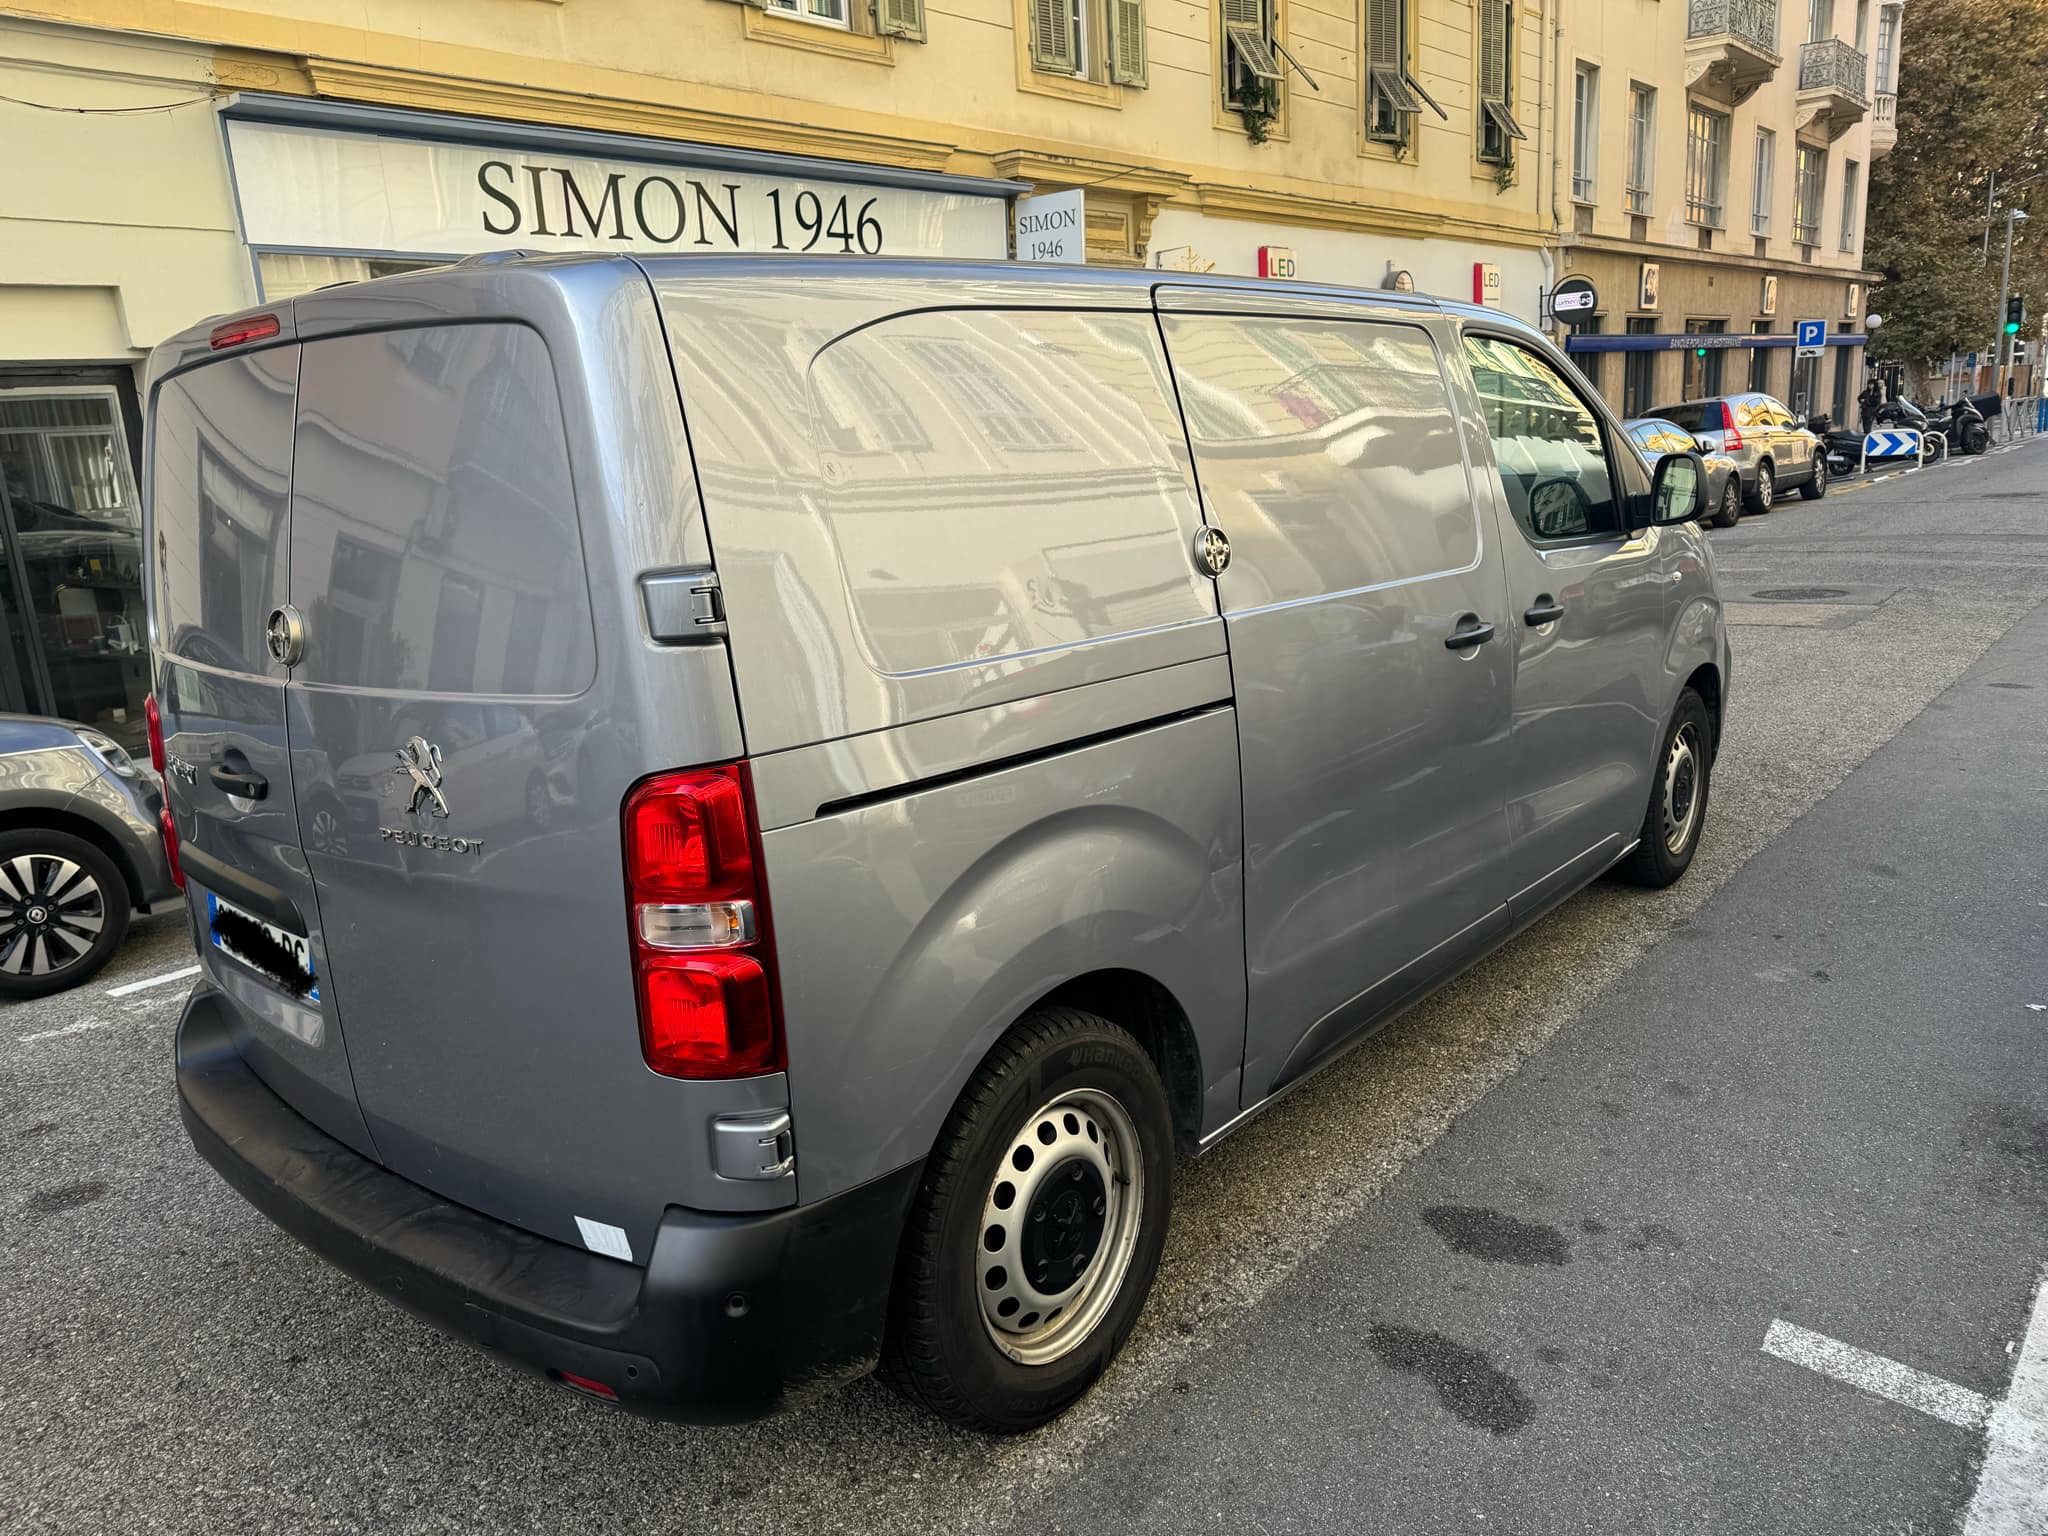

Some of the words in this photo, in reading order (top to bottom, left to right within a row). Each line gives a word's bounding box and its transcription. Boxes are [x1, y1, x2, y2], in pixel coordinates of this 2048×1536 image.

[477, 160, 742, 248] SIMON
[765, 187, 883, 255] 1946
[1019, 208, 1076, 235] SIMON
[1031, 239, 1064, 260] 1946
[1269, 258, 1295, 278] LED
[1483, 271, 1500, 288] LED
[1805, 325, 1818, 343] P
[378, 827, 485, 856] PEUGEOT
